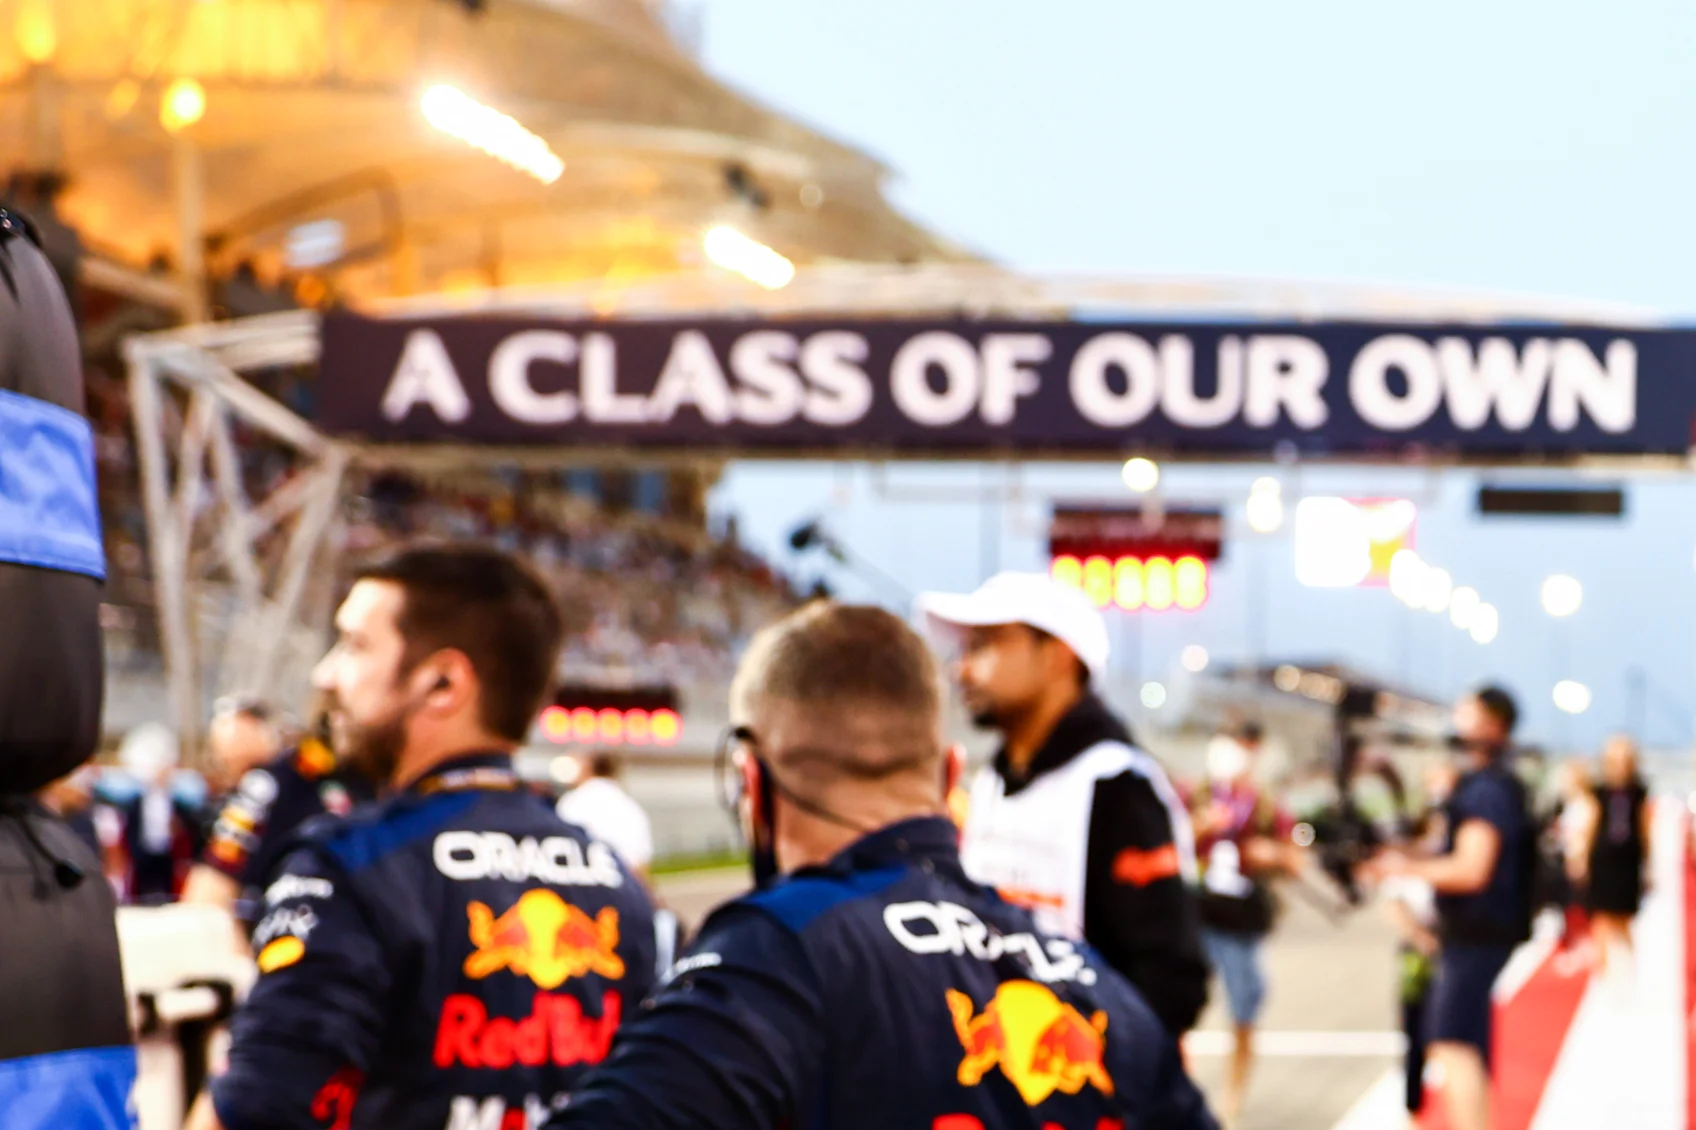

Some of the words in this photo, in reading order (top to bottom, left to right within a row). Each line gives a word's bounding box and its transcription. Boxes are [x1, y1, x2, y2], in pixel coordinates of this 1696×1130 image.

[382, 328, 471, 424] A
[487, 329, 873, 425] CLASS
[889, 330, 1053, 427] OF
[1069, 332, 1330, 430] OUR
[1347, 333, 1638, 433] OWN
[432, 830, 624, 888] ORACLE
